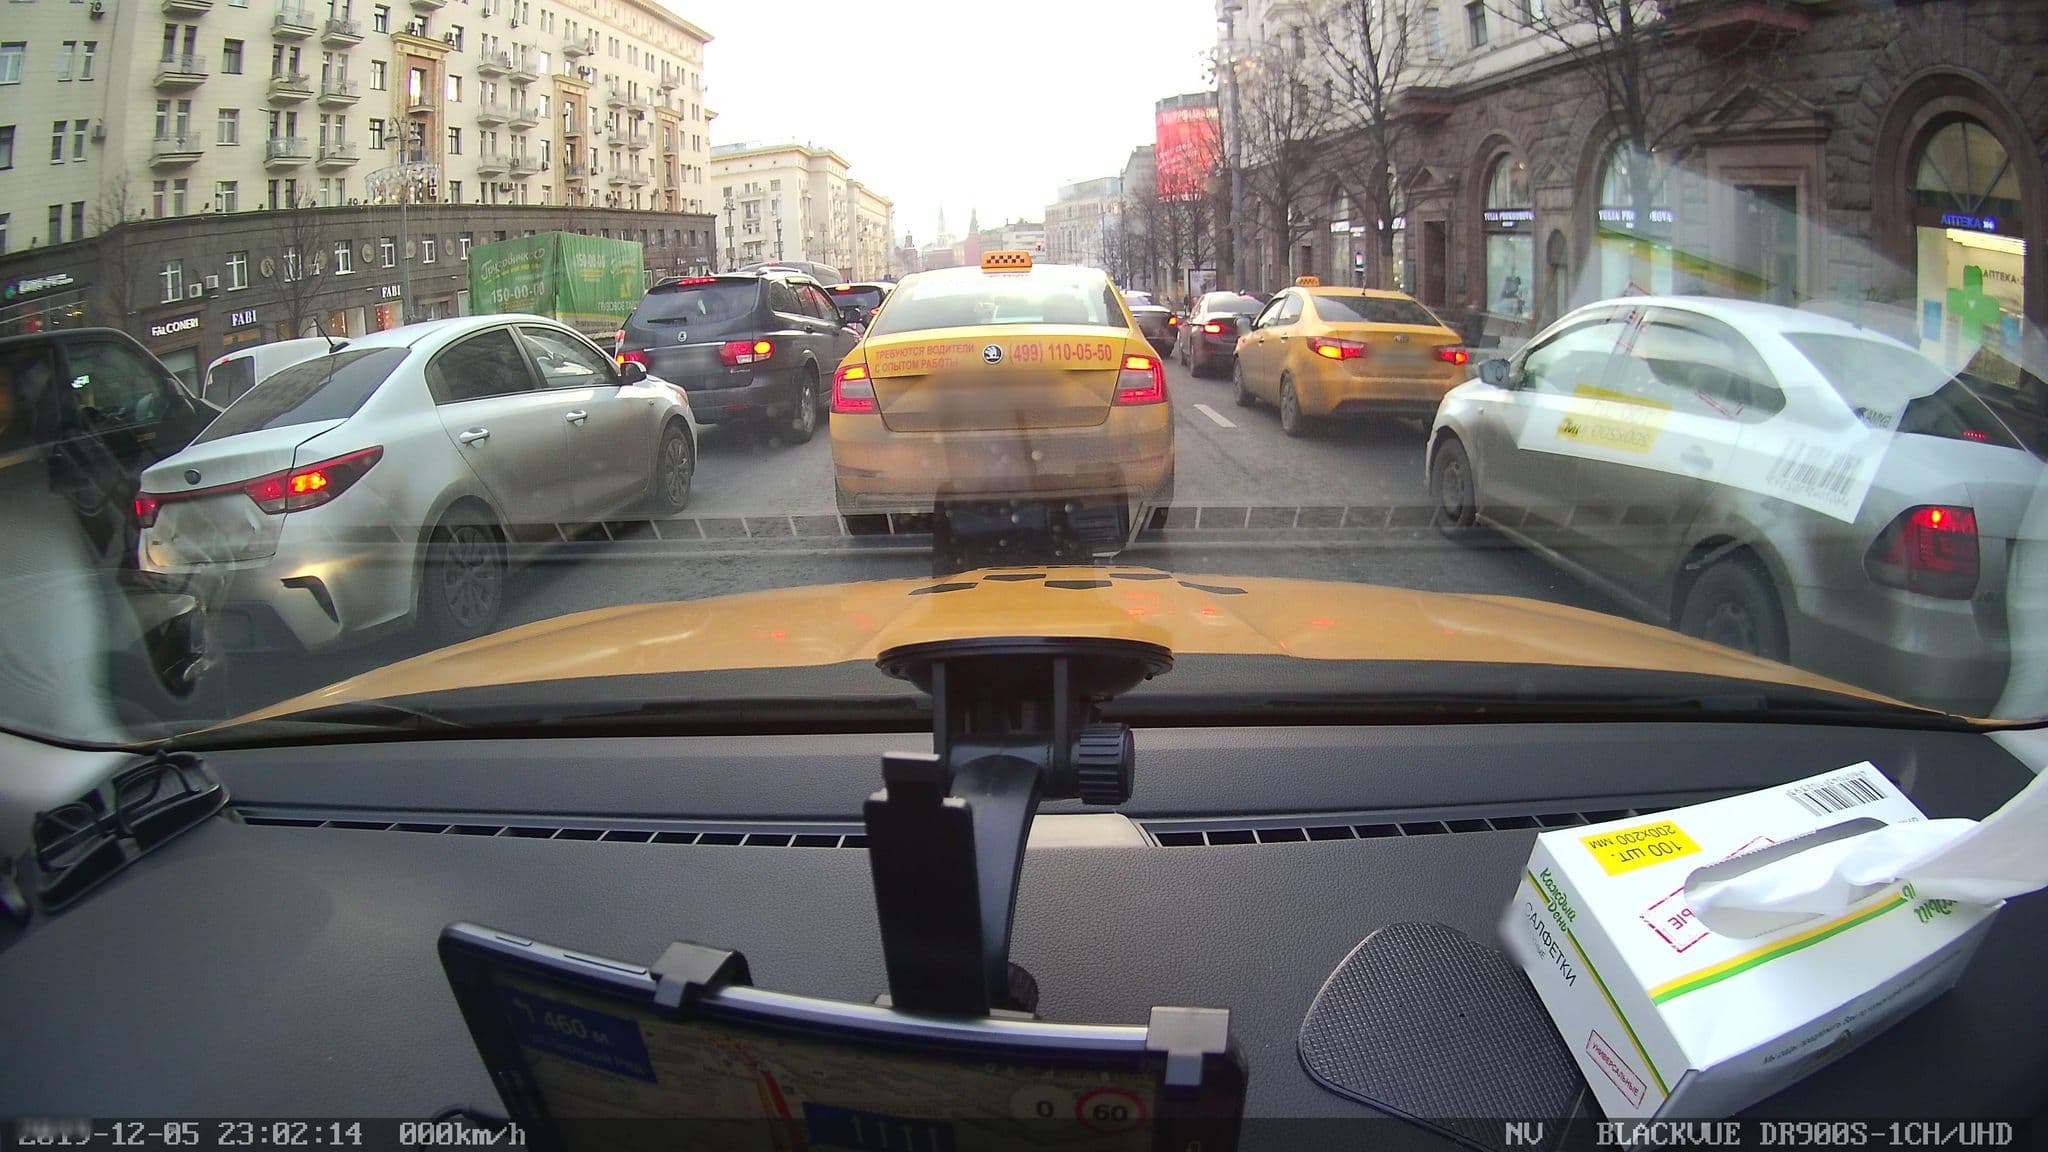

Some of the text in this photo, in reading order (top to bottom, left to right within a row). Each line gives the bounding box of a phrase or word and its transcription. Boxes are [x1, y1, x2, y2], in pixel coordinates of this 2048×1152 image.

[1941, 214, 1982, 228] АПТЕКА
[1983, 269, 2017, 284] АПТЕКА
[381, 284, 401, 298] FABI
[151, 318, 199, 336] FALCONERI
[231, 310, 257, 327] FABI
[876, 343, 975, 360] ТРЕБУЮТСЯ ВОДИТЕЛИ
[1009, 341, 1112, 364] (499) 110-05-50
[882, 361, 919, 373] ОПЫТОМ
[1647, 840, 1682, 857] 100
[1524, 902, 1577, 987] САЛФЕТКИ
[544, 1011, 588, 1039] 460
[1592, 1043, 1639, 1097] УНИВЕРСАЛЬНЫЕ
[1036, 1101, 1054, 1118] 0
[1093, 1104, 1128, 1121] 60
